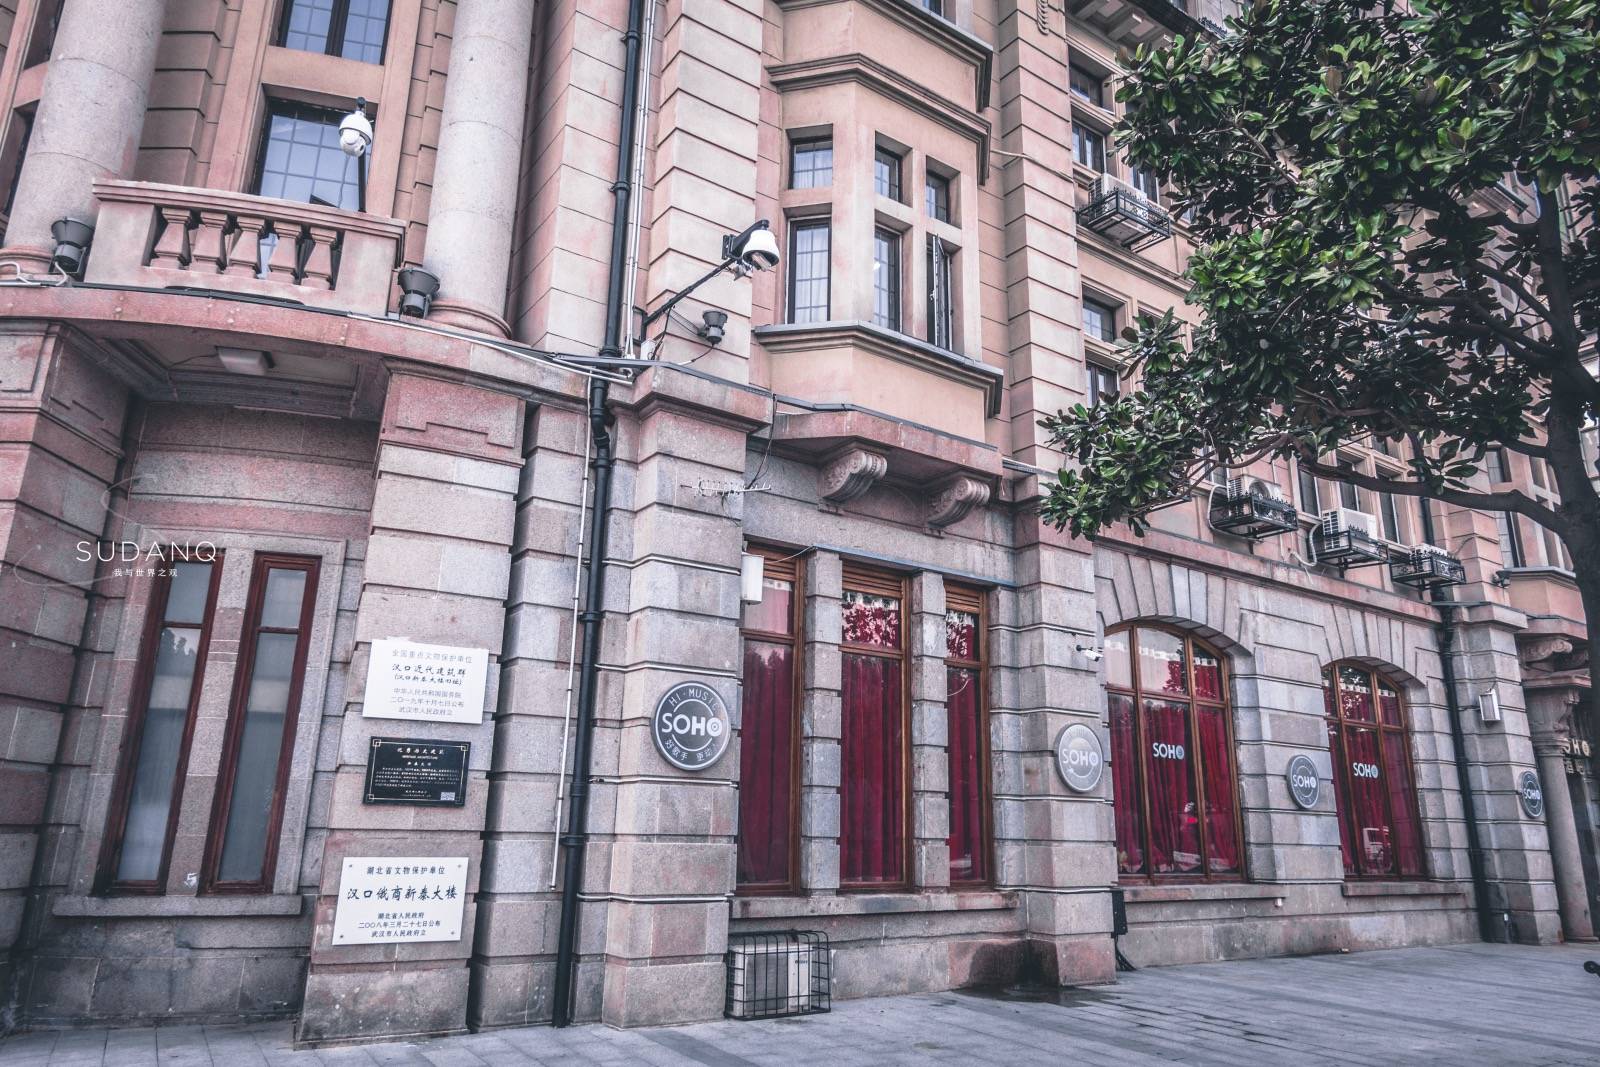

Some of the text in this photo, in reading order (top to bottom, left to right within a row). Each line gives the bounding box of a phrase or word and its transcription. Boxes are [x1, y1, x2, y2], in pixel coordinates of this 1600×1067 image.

[392, 664, 467, 677] 汉口近代建筑群
[669, 693, 681, 707] HI
[661, 713, 723, 737] SOHO
[1062, 748, 1099, 767] SOHO
[1152, 742, 1185, 760] SOHO
[1352, 762, 1379, 779] SOHO
[1292, 774, 1317, 789] SOHO
[1523, 788, 1541, 800] SOHO
[367, 866, 446, 875] 湖北省文物保护单位
[347, 884, 459, 901] 汉口俄商新泰大楼
[371, 929, 427, 938] 武汉市人民政府立
